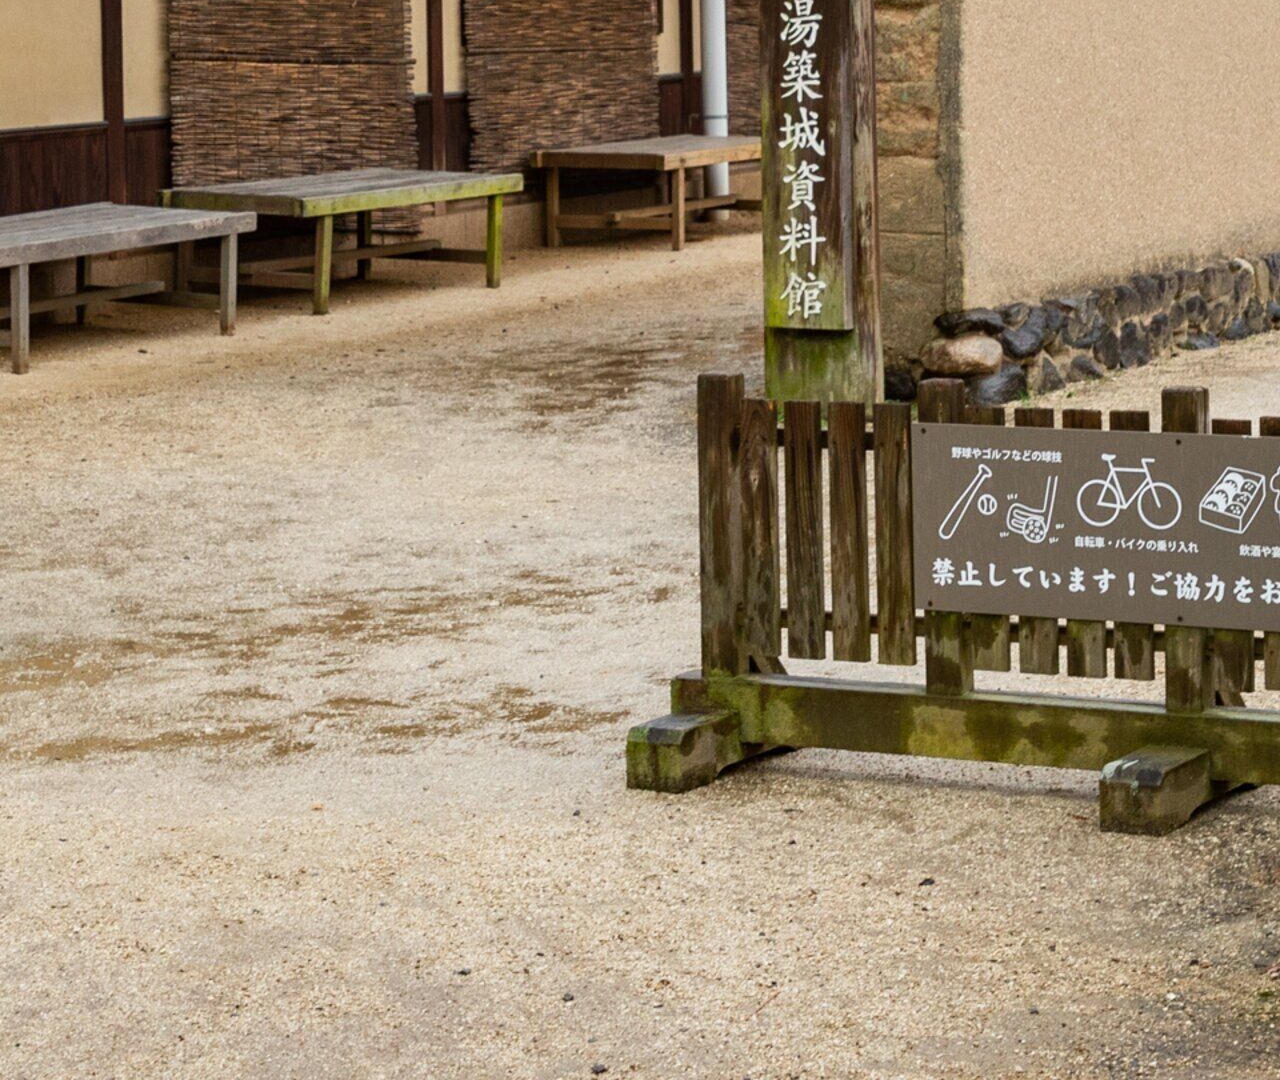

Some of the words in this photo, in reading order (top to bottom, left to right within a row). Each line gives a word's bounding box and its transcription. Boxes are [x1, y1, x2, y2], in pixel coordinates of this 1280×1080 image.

[951, 446, 1063, 464] 野球やゴルフなどの球技
[1074, 535, 1199, 554] 自転車・バイクの乗り入れ
